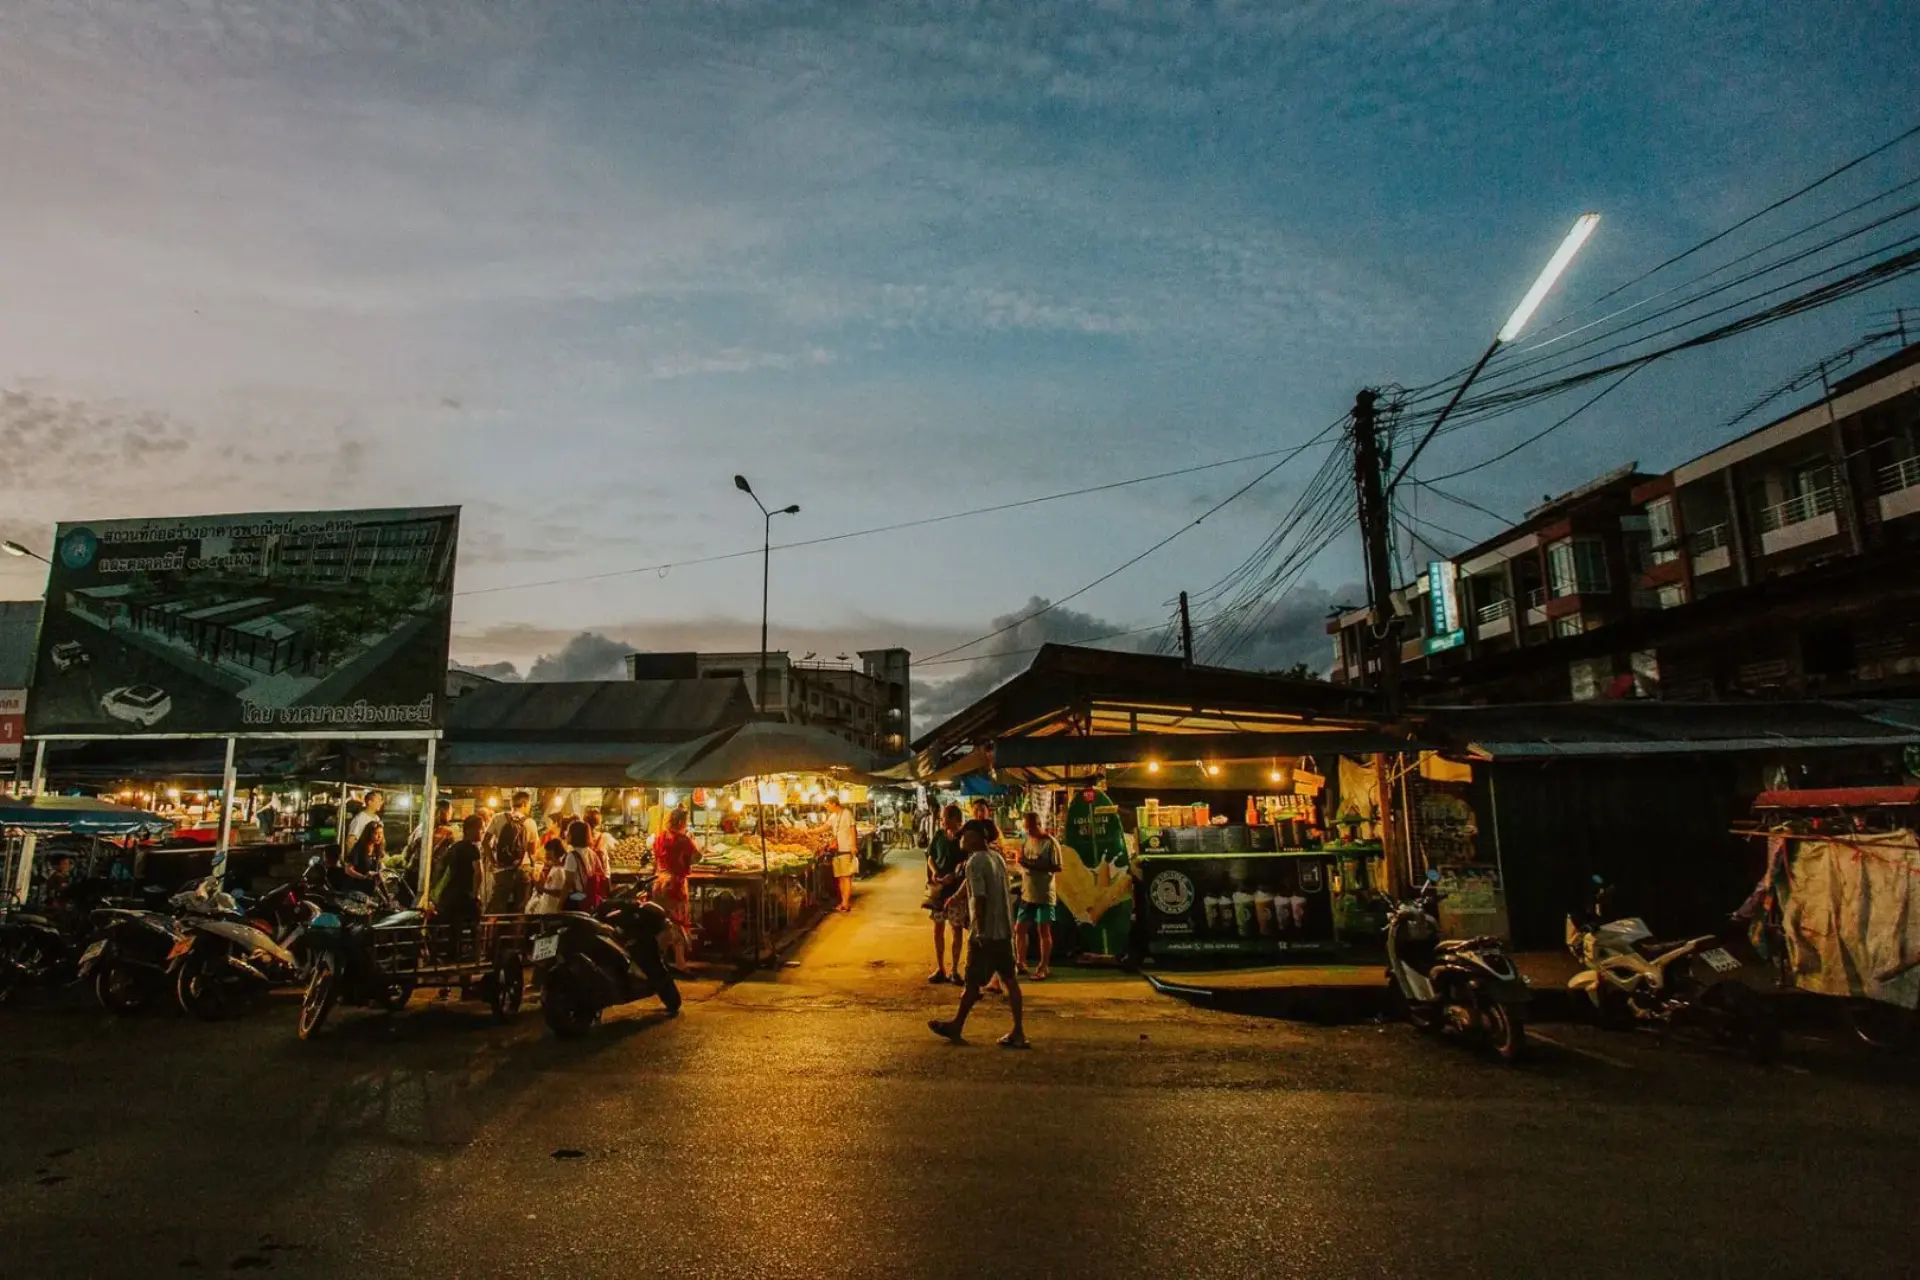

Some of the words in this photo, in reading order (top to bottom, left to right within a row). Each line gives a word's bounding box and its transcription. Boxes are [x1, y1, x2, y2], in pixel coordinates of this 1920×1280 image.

[242, 699, 273, 724] โดย
[280, 692, 434, 724] เทศบาลเมืองกระบี่
